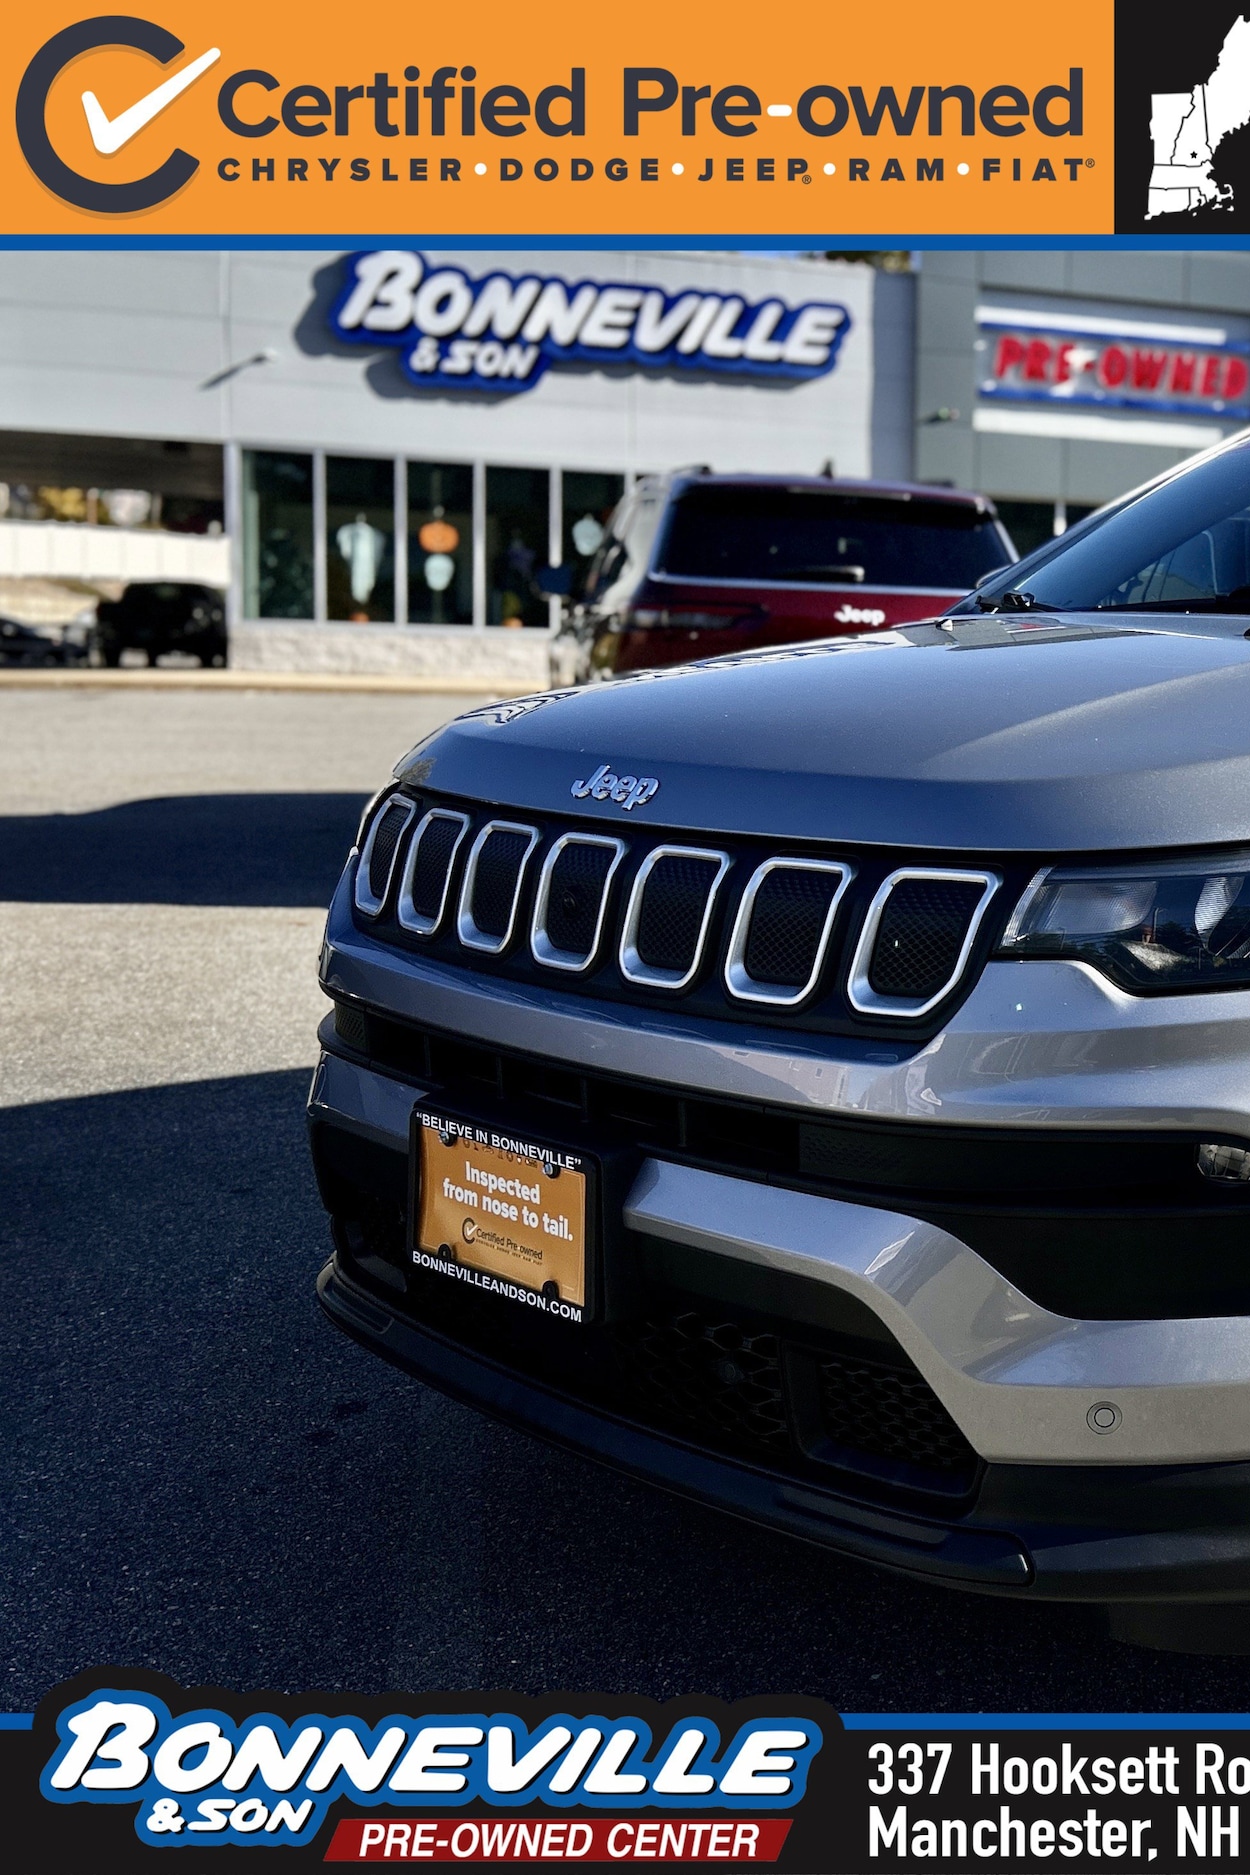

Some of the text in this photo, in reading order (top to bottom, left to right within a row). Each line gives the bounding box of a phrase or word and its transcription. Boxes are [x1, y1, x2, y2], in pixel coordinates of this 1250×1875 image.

[338, 250, 848, 364] BONNEVILLE
[410, 336, 539, 379] & SON
[833, 603, 886, 627] Jeep
[571, 765, 660, 811] Jeep
[475, 1128, 488, 1145] IN
[465, 1160, 541, 1205] Inspected
[442, 1177, 574, 1242] from nose to tail.
[476, 1228, 505, 1246] Certified
[412, 1250, 582, 1323] BONNEVILLEANDSON.COM
